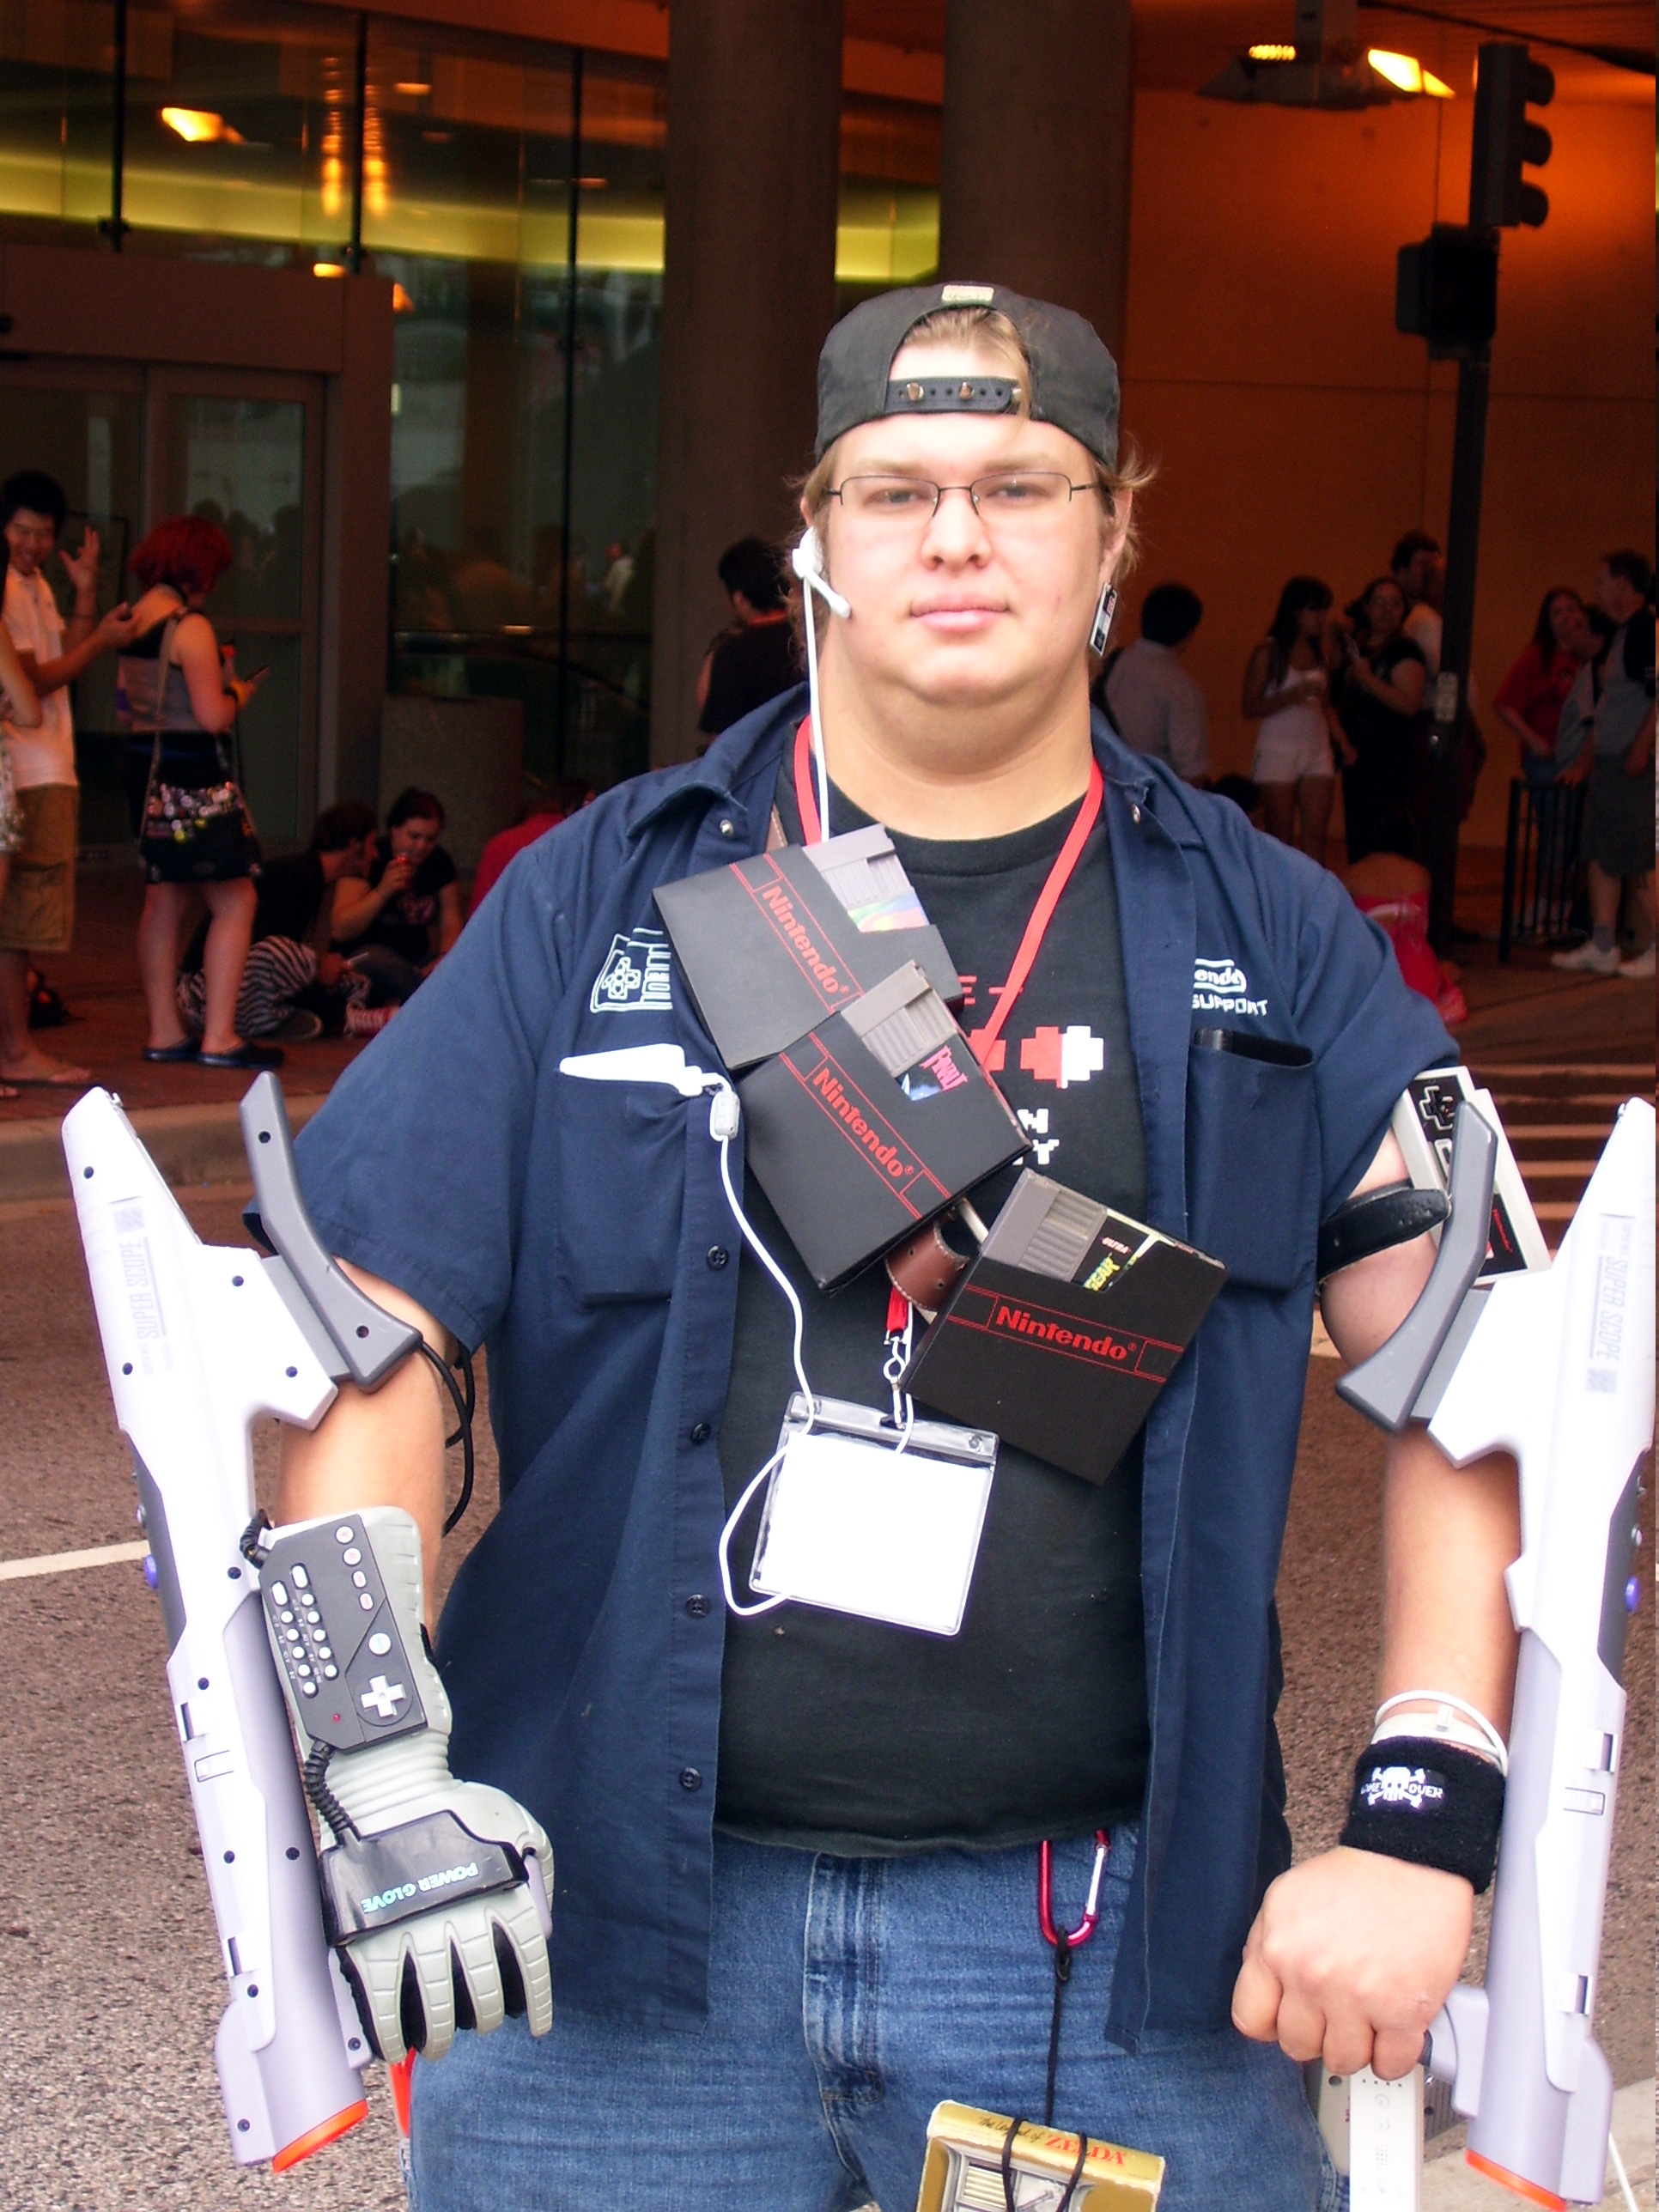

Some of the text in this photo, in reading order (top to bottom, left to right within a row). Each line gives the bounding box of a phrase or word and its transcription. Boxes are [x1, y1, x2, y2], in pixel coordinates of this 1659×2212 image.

[1191, 994, 1268, 1016] SUPPORT
[118, 1242, 149, 1287] SCOPE
[1602, 1255, 1629, 1308] SUPER
[130, 1292, 161, 1340] SUPER
[1597, 1310, 1624, 1362] SCOPE
[361, 1862, 479, 1913] POWER GLOVE
